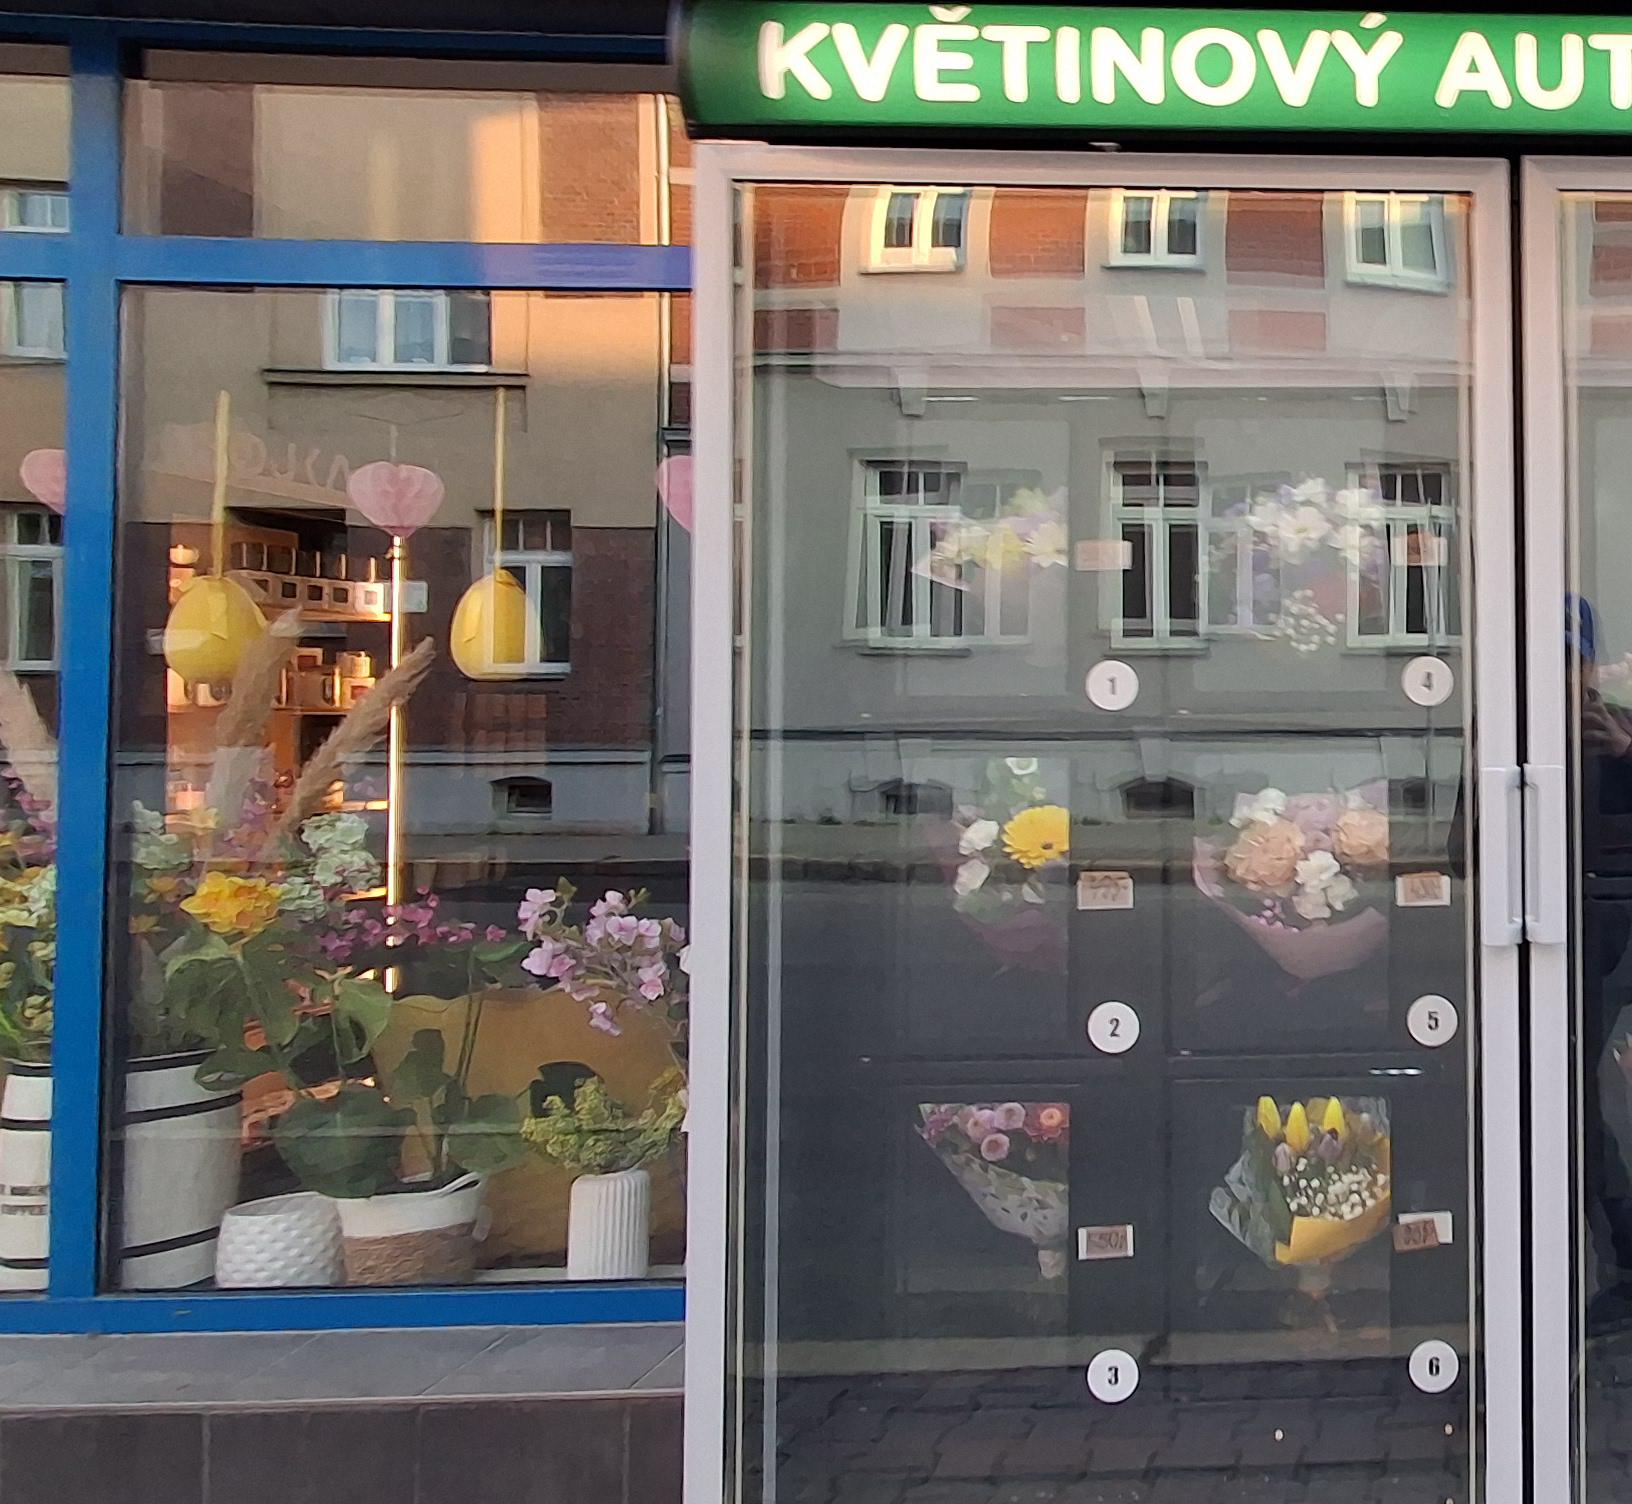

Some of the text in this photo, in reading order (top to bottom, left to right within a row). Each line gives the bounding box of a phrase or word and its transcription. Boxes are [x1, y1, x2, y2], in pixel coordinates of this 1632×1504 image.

[757, 5, 1404, 108] KVĚTINOVÝ
[1107, 676, 1116, 694] 1
[1421, 671, 1434, 692] 4
[1109, 1017, 1119, 1037] 2
[1427, 1011, 1439, 1031] 5
[1427, 1356, 1439, 1376] 6
[1106, 1367, 1118, 1386] 3
